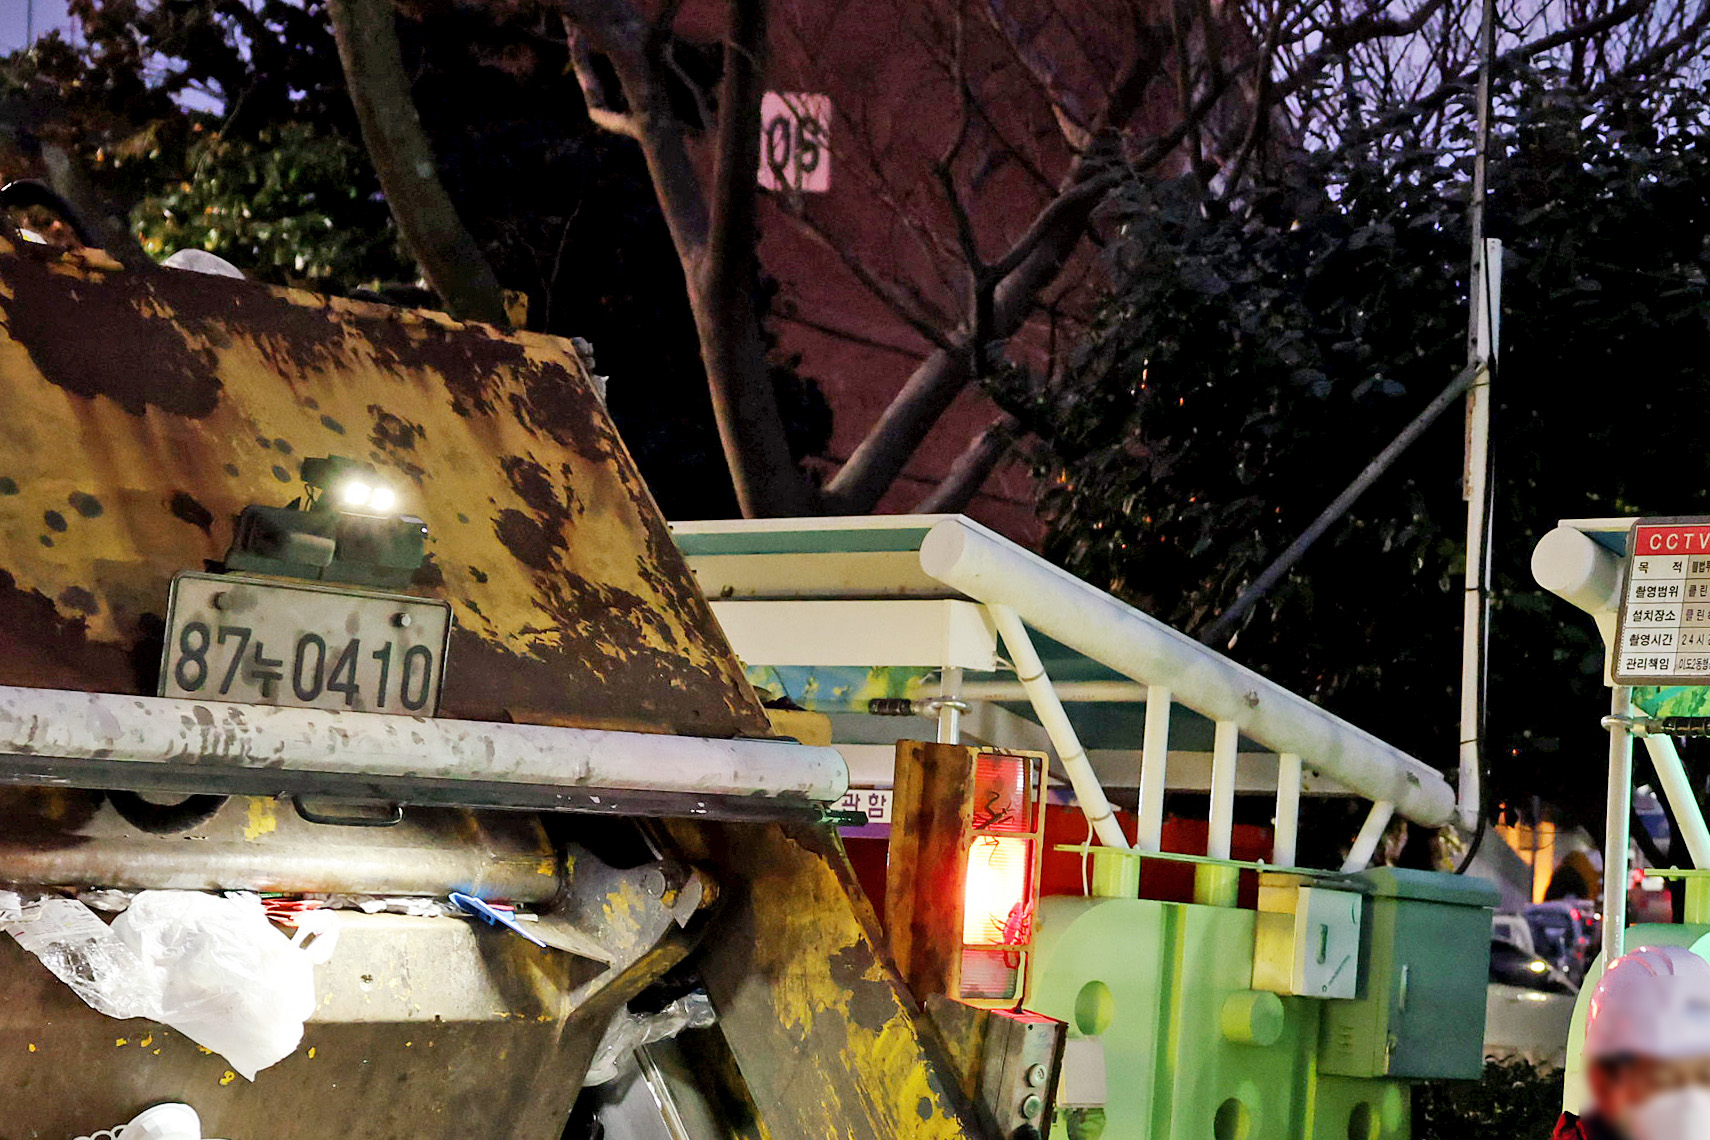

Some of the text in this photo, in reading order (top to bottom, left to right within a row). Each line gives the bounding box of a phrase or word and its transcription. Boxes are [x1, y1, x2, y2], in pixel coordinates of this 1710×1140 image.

[1650, 532, 1710, 550] CCTV
[1638, 561, 1682, 574] 목 적
[1635, 585, 1679, 598] 촬영범위
[1632, 609, 1676, 622] 설치장소
[1629, 633, 1673, 647] 촬영시간
[175, 621, 433, 711] 87누0410
[1626, 658, 1669, 671] 관리책임
